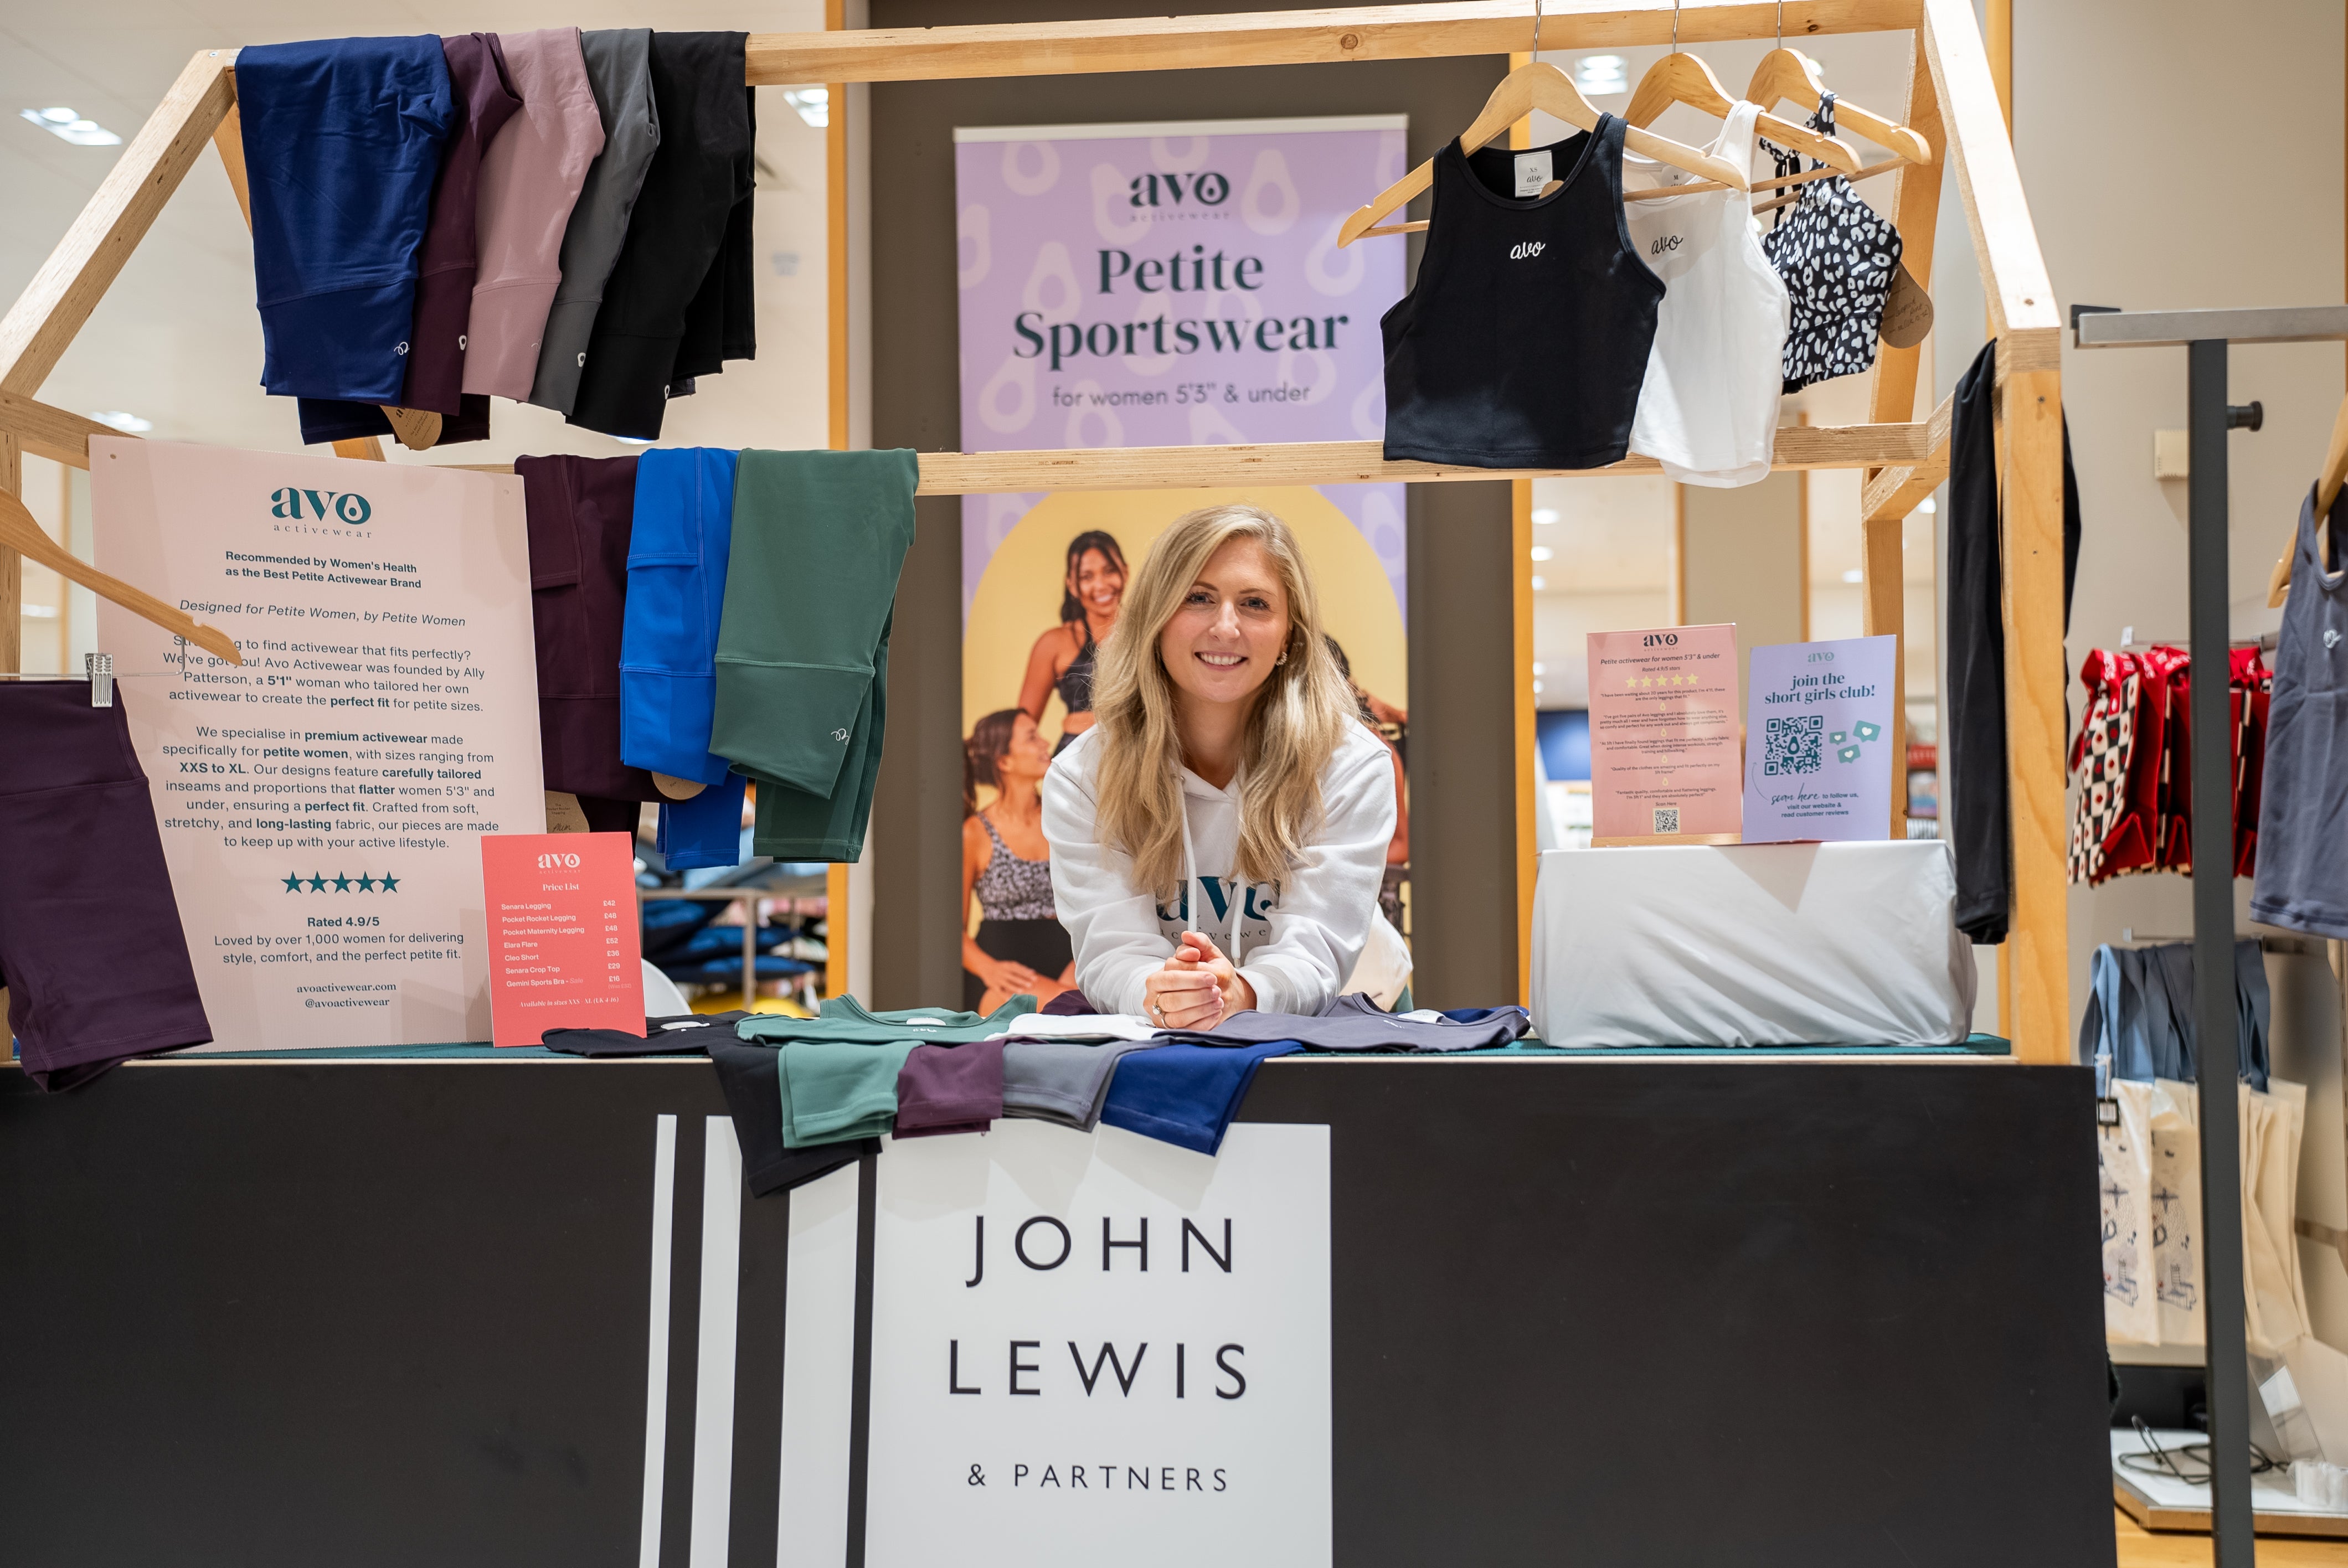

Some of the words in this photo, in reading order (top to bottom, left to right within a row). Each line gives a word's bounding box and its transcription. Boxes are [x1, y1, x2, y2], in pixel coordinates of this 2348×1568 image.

[1129, 172, 1230, 208] avo
[1510, 241, 1546, 259] avo
[1651, 235, 1683, 255] avo
[1098, 244, 1263, 293] Petite
[1013, 312, 1348, 372] Sportswear
[1052, 385, 1083, 407] for
[1089, 390, 1168, 406] women
[1175, 382, 1217, 404] 5'3"
[1223, 383, 1239, 403] &
[1248, 381, 1310, 403] under
[271, 487, 372, 525] avo
[274, 525, 372, 538] activewear
[225, 550, 310, 565] Recommended
[313, 557, 327, 569] by
[329, 558, 380, 570] Women's
[383, 562, 416, 573] Health
[241, 568, 260, 577] the
[263, 569, 289, 579] Best
[292, 570, 324, 581] Petite
[327, 573, 388, 586] Activewear
[390, 577, 421, 588] Brand
[179, 600, 242, 615] Designed
[246, 604, 264, 614] for
[267, 605, 305, 617] Petite
[310, 607, 359, 622] Women,
[364, 611, 379, 623] by
[382, 612, 418, 623] Petite
[421, 614, 465, 626] Women
[1644, 634, 1678, 646] avo
[246, 639, 259, 649] to
[262, 639, 287, 651] find
[291, 642, 359, 654] activewear
[362, 645, 387, 656] that
[389, 646, 408, 657] fits
[412, 648, 471, 662] perfectly?
[1807, 651, 1835, 663] avo
[163, 653, 203, 664] We've
[234, 657, 260, 669] ou!
[265, 657, 289, 668] Avo
[293, 658, 363, 672] Activewear
[365, 664, 390, 673] was
[393, 663, 442, 675] founded
[446, 666, 460, 679] by
[464, 667, 485, 680] Ally
[184, 672, 251, 687] Patterson,
[267, 675, 292, 686] 5'1"
[295, 678, 340, 688] woman
[344, 679, 369, 690] who
[373, 680, 419, 692] tailored
[422, 682, 442, 693] her
[445, 685, 469, 694] own
[1790, 675, 1818, 691] join
[1822, 673, 1845, 684] the
[1764, 692, 1801, 704] short
[1805, 688, 1836, 705] girls
[1840, 685, 1875, 698] club!
[196, 726, 217, 737] We
[222, 728, 286, 740] specialise
[290, 729, 300, 739] in
[305, 730, 359, 742] premium
[362, 732, 428, 744] activewear
[431, 734, 463, 745] made
[179, 762, 208, 773] XXS
[211, 763, 225, 773] to
[229, 763, 249, 774] XL.
[254, 764, 278, 775] Our
[281, 765, 331, 778] designs
[334, 766, 378, 777] feature
[382, 767, 434, 781] carefully
[436, 768, 481, 779] tailored
[1798, 782, 1819, 801] here
[224, 836, 237, 847] to
[241, 835, 273, 849] keep
[277, 838, 293, 849] up
[296, 837, 323, 847] with
[327, 839, 355, 849] your
[359, 837, 395, 847] active
[399, 837, 449, 850] lifestyle.
[538, 853, 580, 868] avo
[307, 917, 342, 927] Rated
[345, 916, 380, 926] 4.9/5
[297, 982, 397, 993] avoactivewear.com
[305, 997, 390, 1008] @avoactivewear
[965, 1215, 1232, 1288] JOHN
[949, 1339, 1246, 1400] LEWIS
[967, 1463, 986, 1486] &
[1015, 1463, 1226, 1492] PARTNERS
